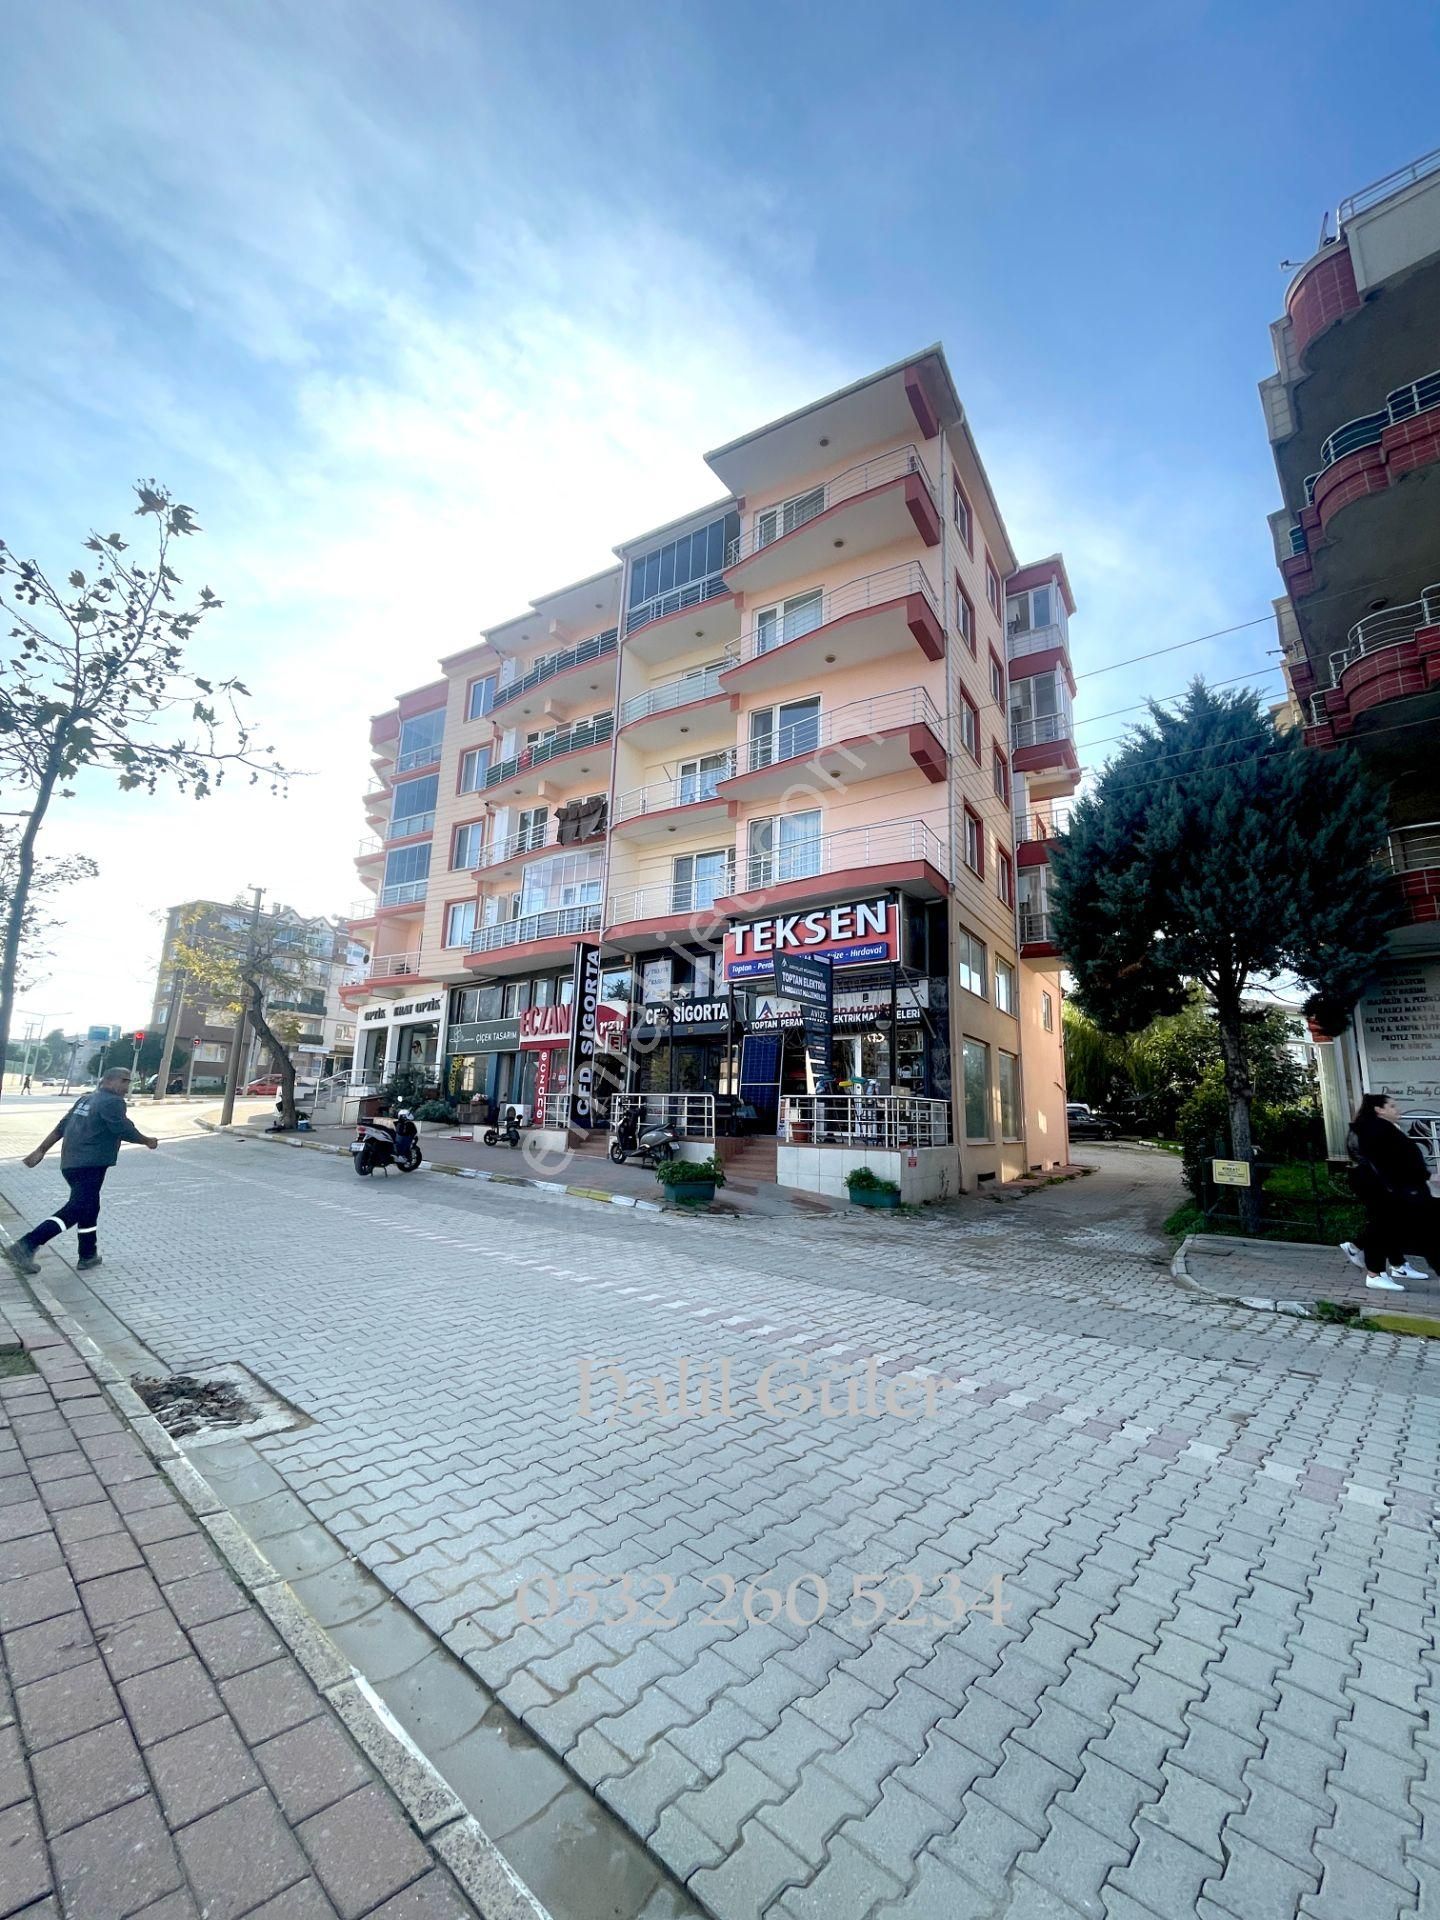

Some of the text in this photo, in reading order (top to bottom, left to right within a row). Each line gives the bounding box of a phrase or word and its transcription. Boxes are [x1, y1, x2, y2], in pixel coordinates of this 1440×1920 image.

[729, 899, 887, 956] TEKSEN
[732, 963, 752, 974] Toptan
[781, 971, 803, 986] TOPTAN
[520, 1003, 572, 1037] ECZAN
[672, 1001, 729, 1023] SİGORTA
[750, 1020, 778, 1030] TOPTAN
[833, 1012, 861, 1024] EKTRİK
[493, 1031, 517, 1041] TASARIM
[536, 1051, 548, 1120] eczane
[577, 1066, 593, 1116] CFD
